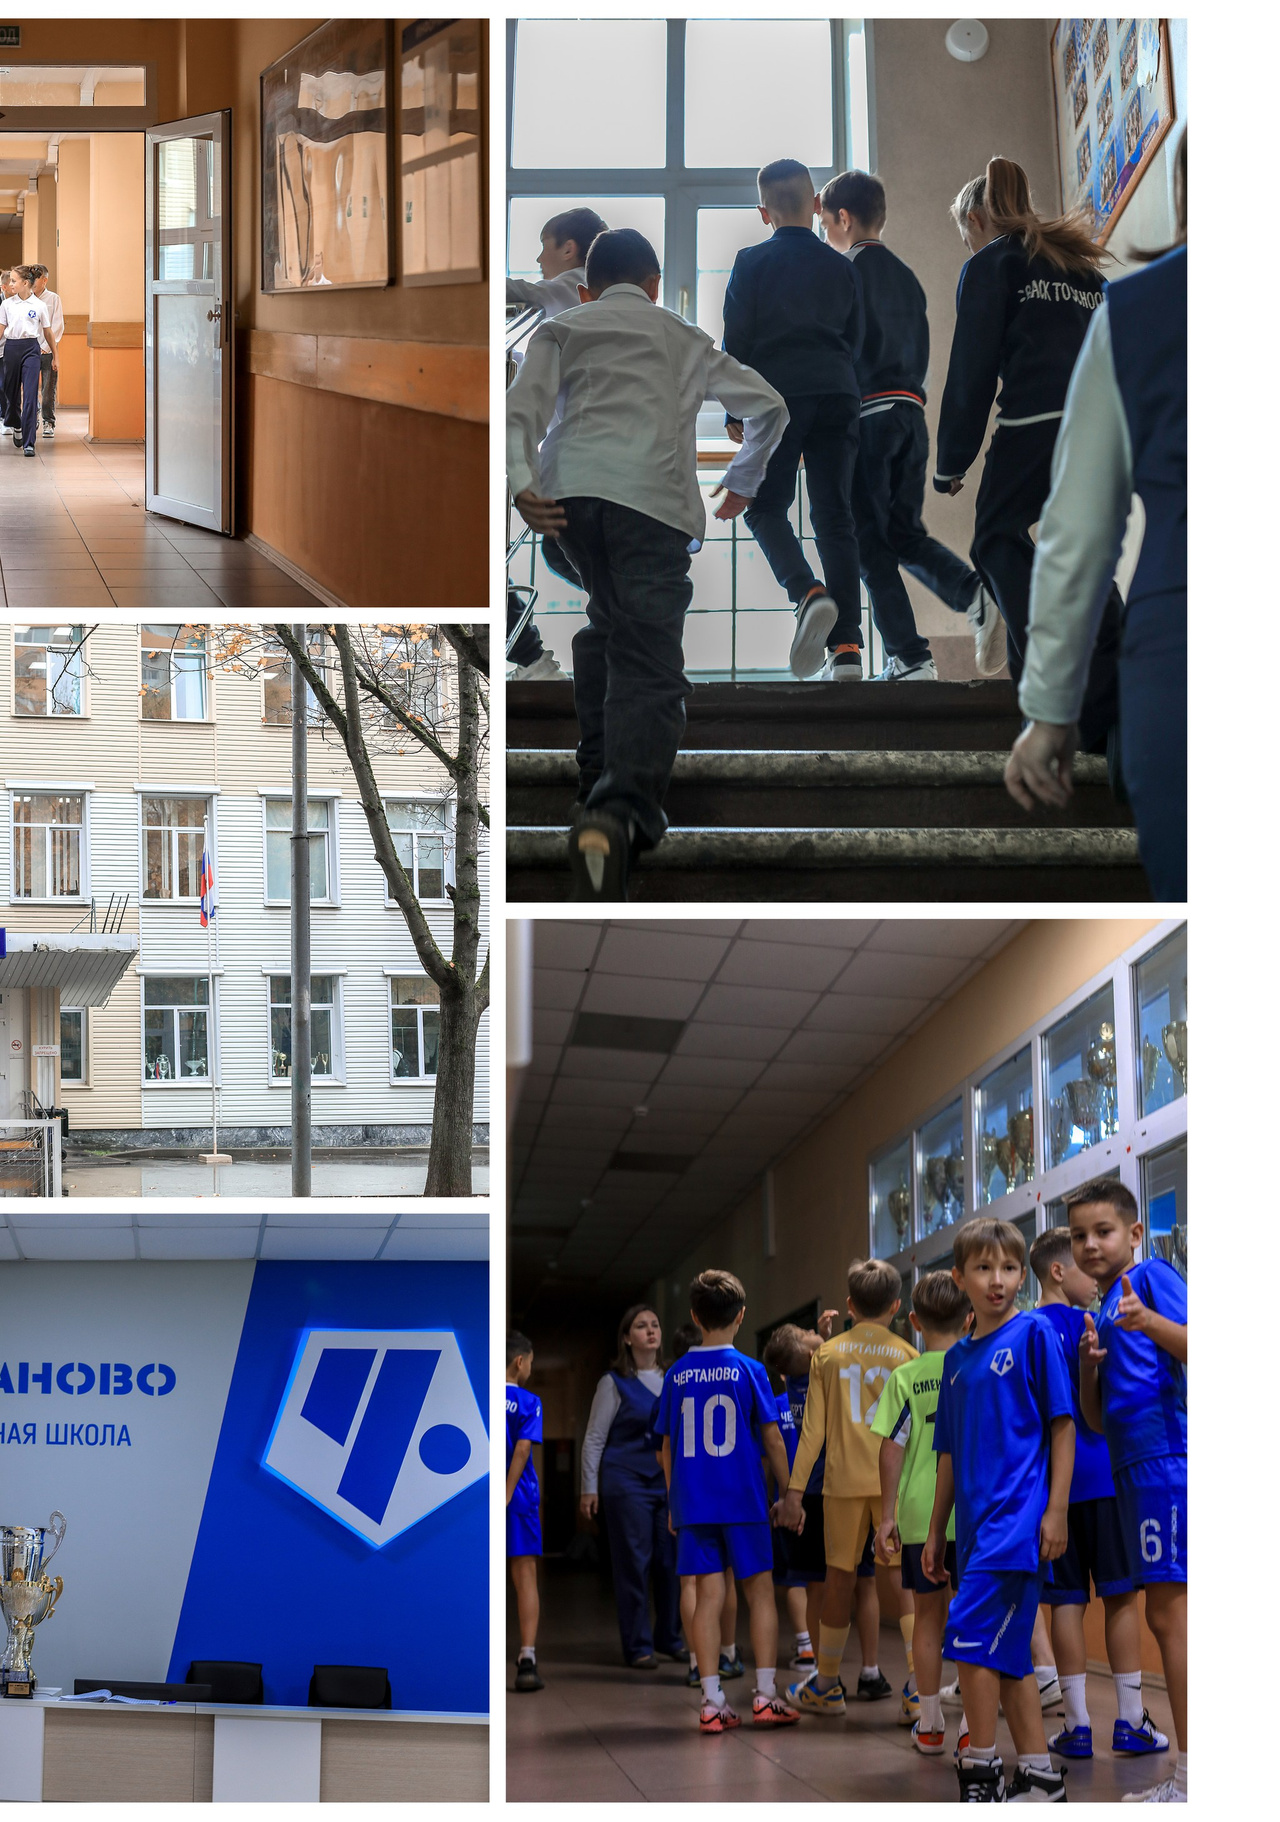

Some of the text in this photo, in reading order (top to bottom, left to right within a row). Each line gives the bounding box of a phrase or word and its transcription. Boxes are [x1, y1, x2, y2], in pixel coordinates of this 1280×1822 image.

[1052, 282, 1071, 301] TO
[835, 1341, 905, 1361] ЧЕРТАНОВО
[673, 1366, 740, 1386] ЧЕРТАНОВО
[46, 1423, 132, 1447] ШКОЛА
[681, 1394, 737, 1458] 10
[1140, 1517, 1163, 1563] 6
